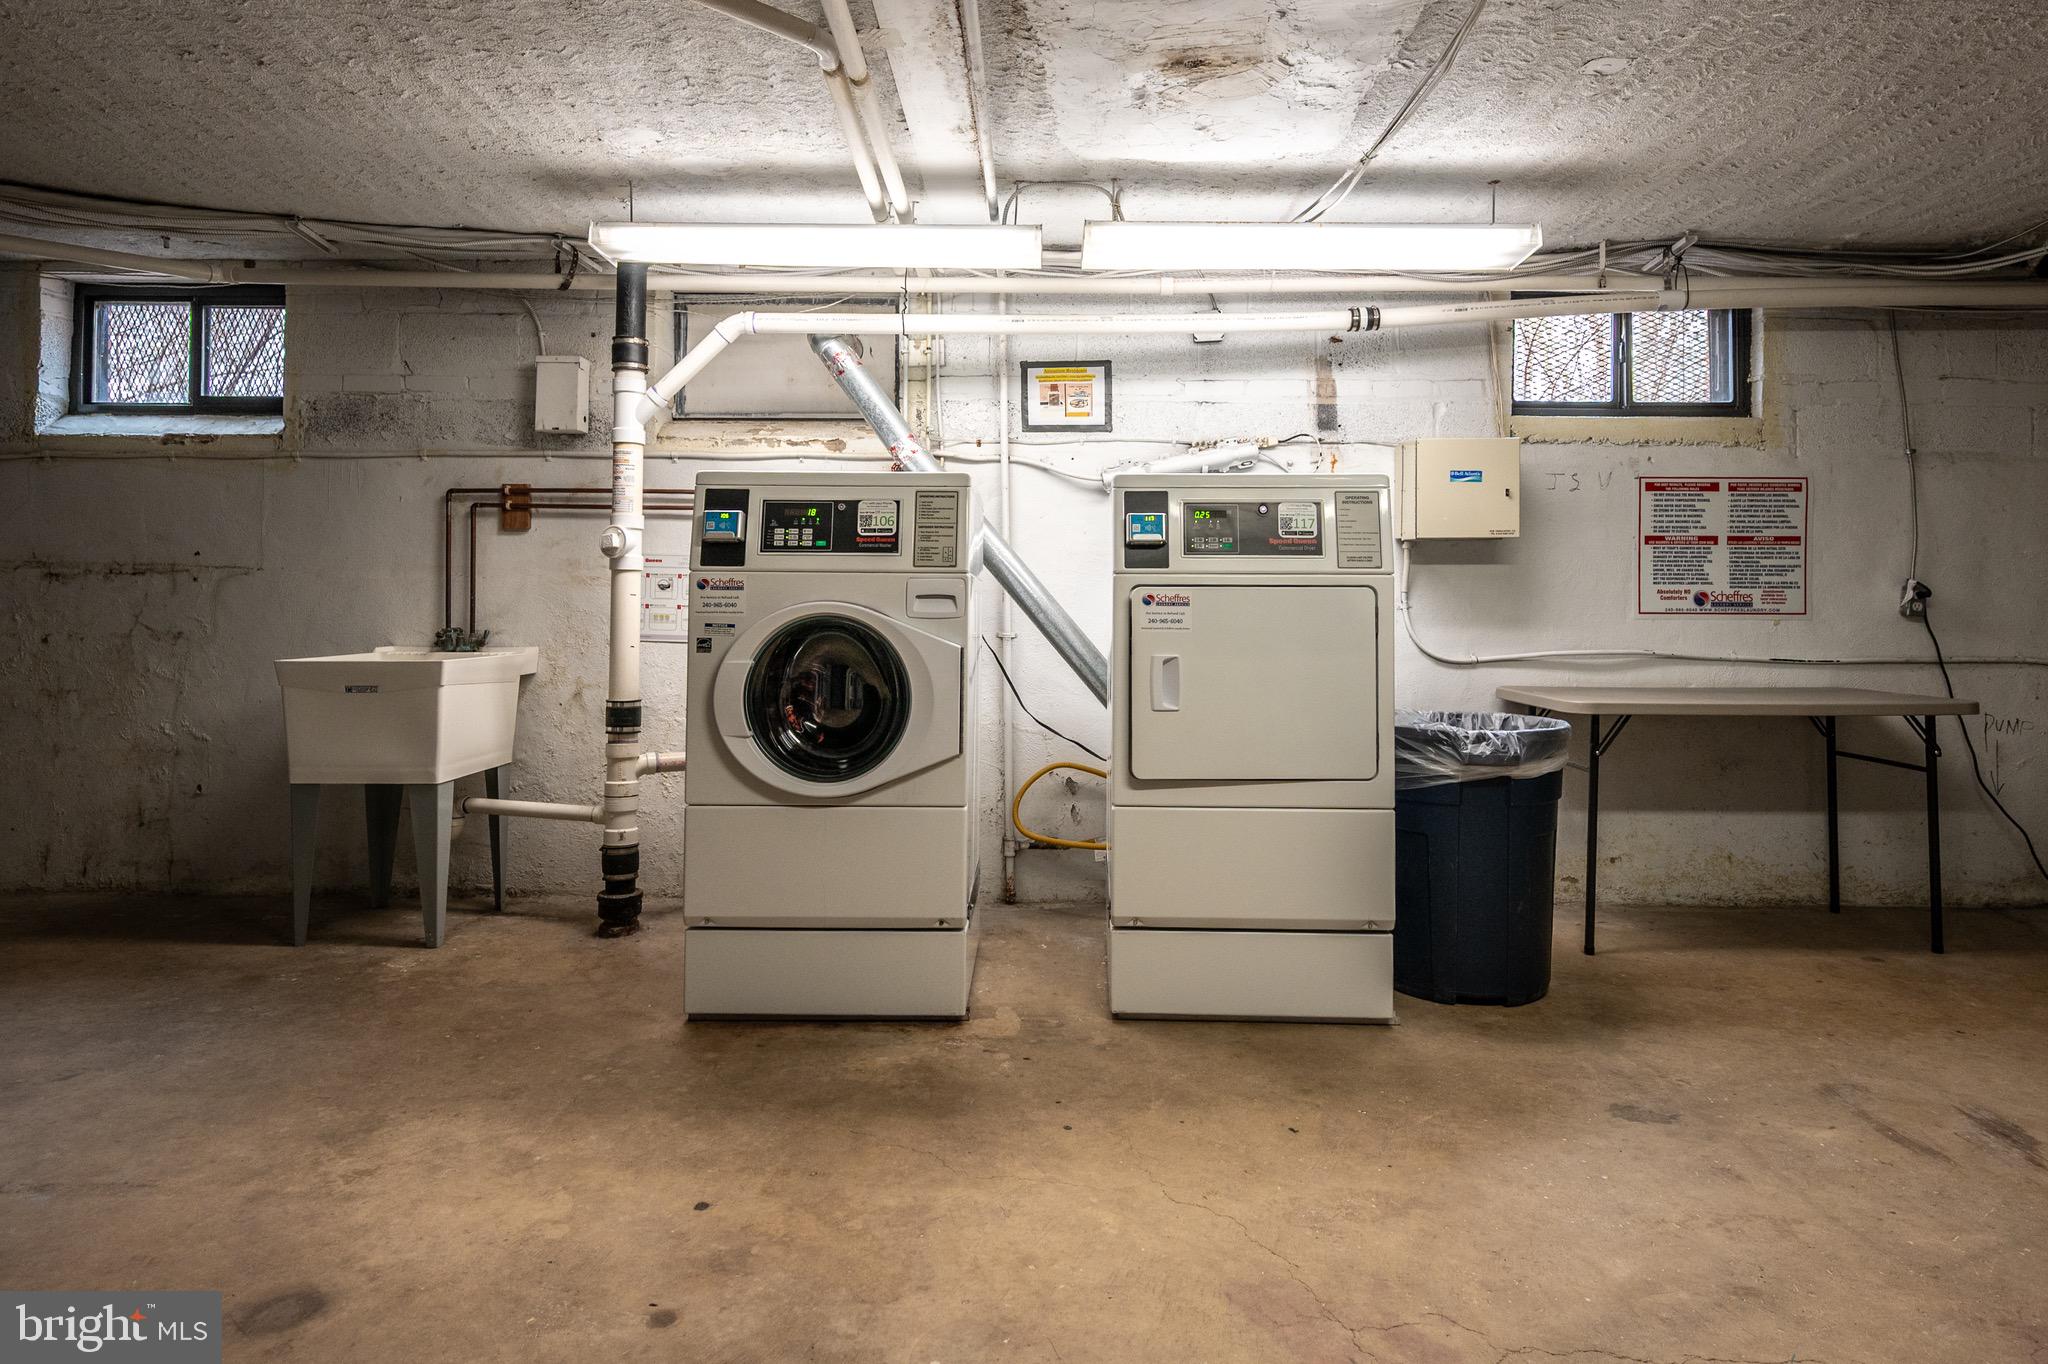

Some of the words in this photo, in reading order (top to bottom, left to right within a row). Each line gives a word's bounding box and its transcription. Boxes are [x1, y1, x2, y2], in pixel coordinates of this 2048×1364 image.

[872, 515, 895, 527] 106
[1293, 518, 1315, 529] 117
[710, 578, 744, 586] Scheffres
[1156, 594, 1190, 602] Scheffres
[1710, 590, 1753, 602] Scheffres
[1984, 712, 2034, 752] PUMP
